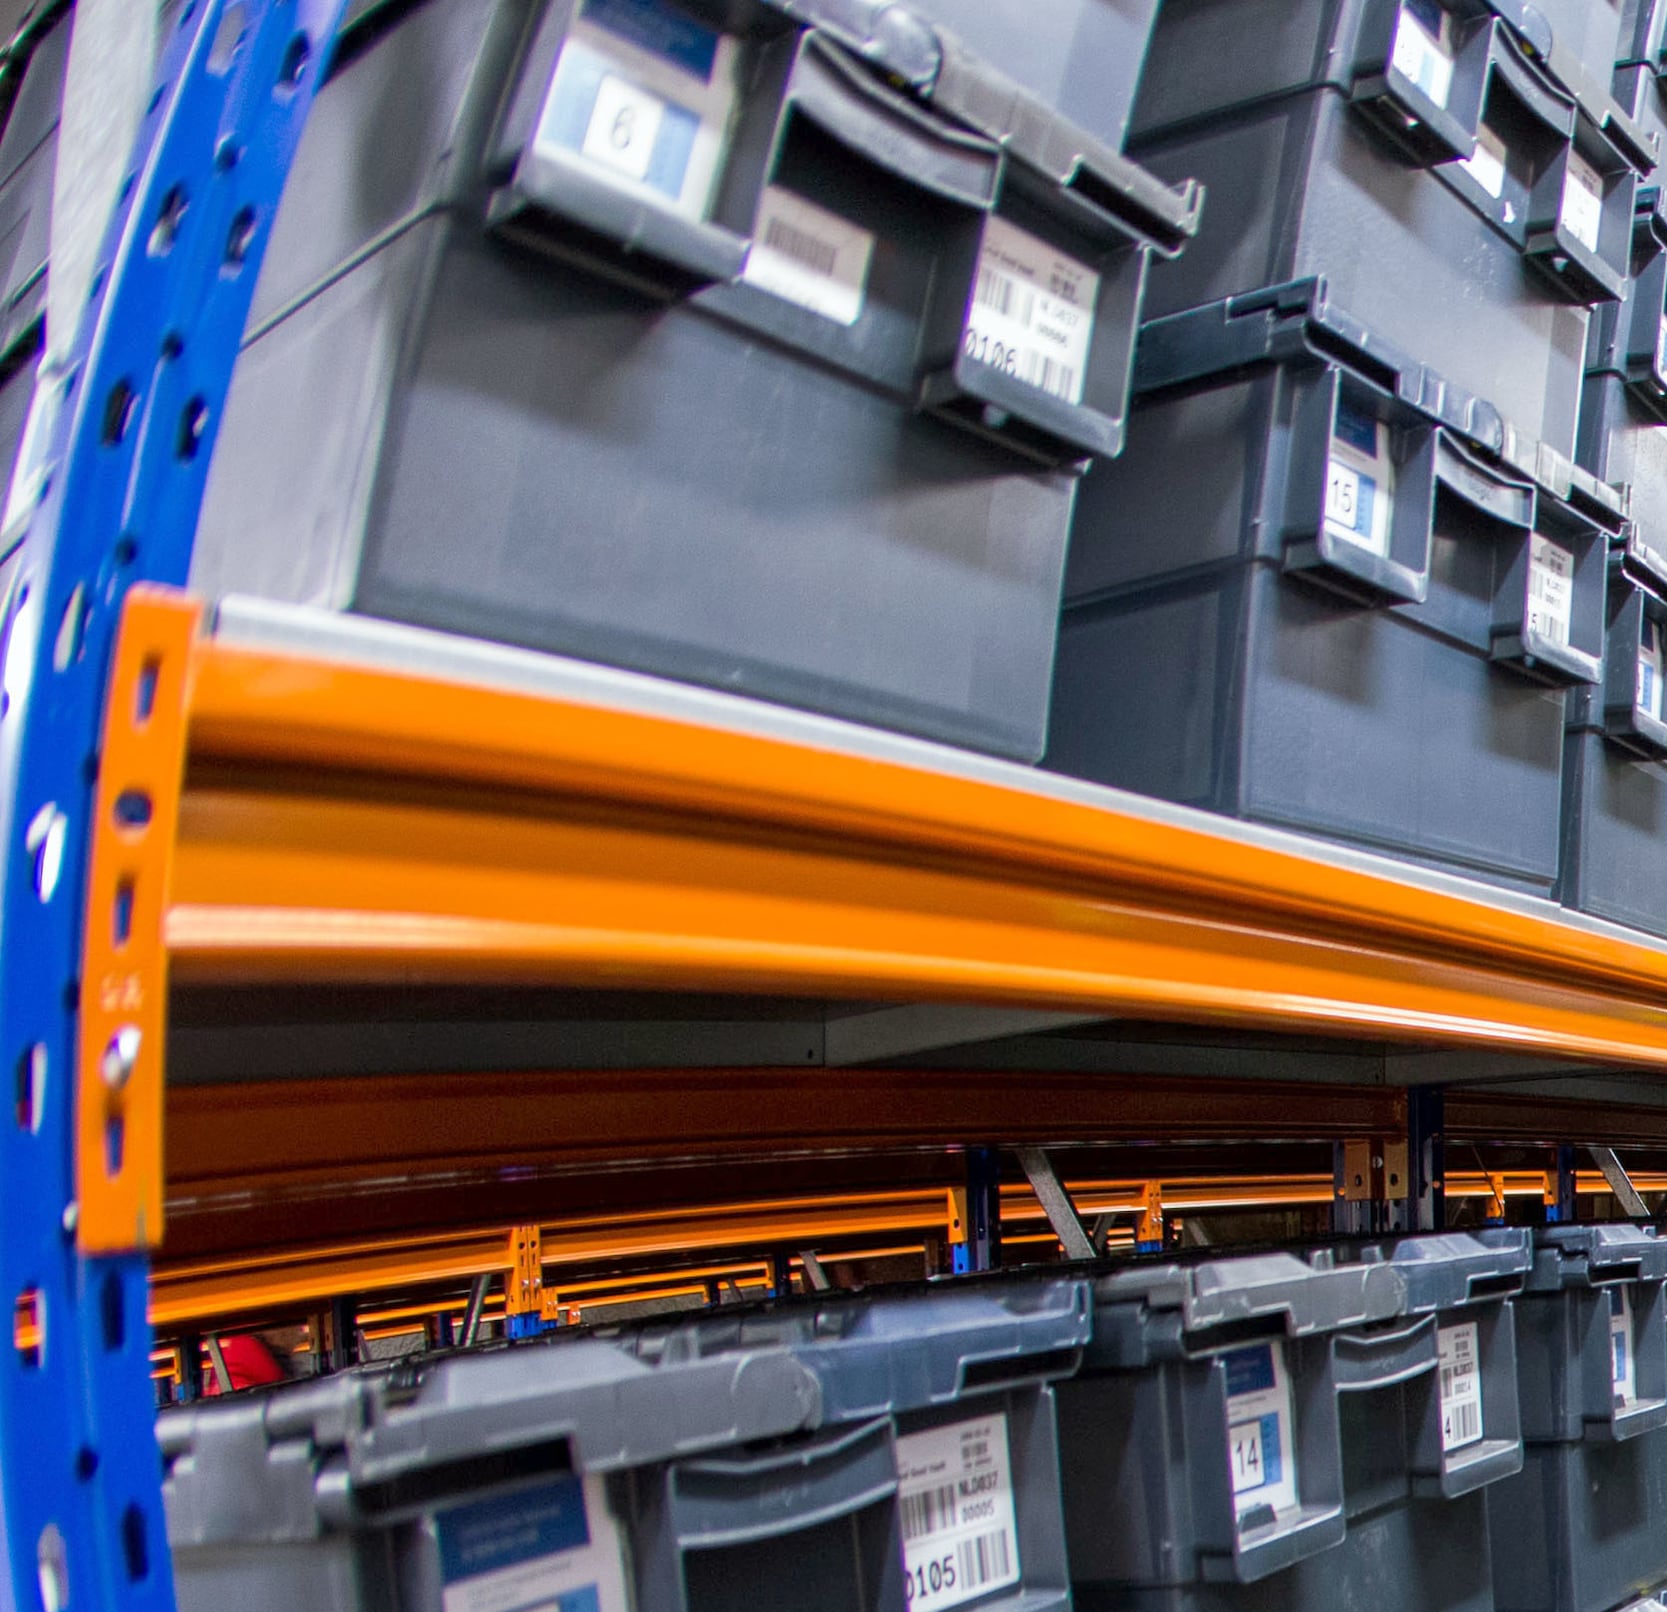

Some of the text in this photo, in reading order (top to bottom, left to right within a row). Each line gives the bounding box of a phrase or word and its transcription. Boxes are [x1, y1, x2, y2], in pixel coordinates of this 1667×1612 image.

[611, 106, 634, 150] 6
[1331, 479, 1352, 513] 15
[1236, 1438, 1259, 1476] 14
